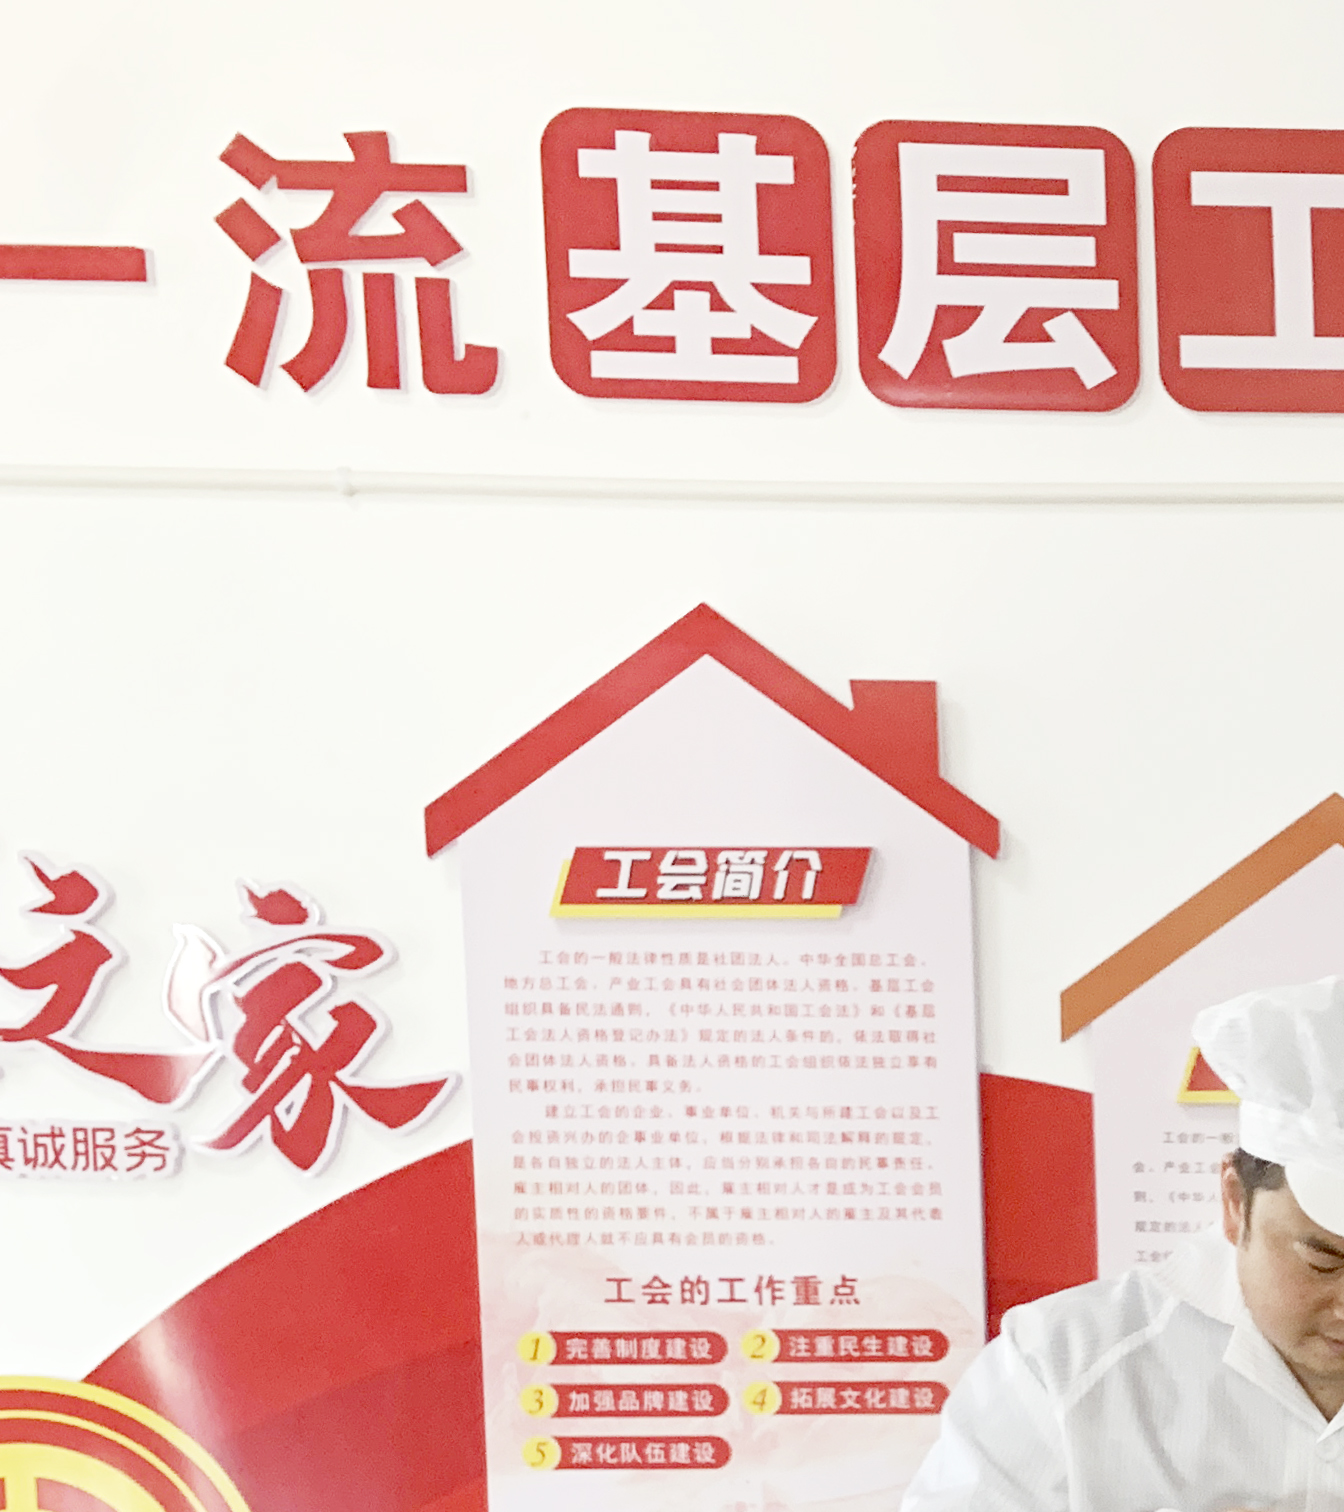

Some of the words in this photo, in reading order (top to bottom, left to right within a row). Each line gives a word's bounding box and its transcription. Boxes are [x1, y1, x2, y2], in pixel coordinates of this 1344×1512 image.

[596, 849, 822, 902] 工会简介
[604, 1275, 860, 1305] 工会的工作重点
[529, 1338, 541, 1361] 1
[566, 1338, 713, 1361] 完善制度建设
[750, 1335, 767, 1358] 2
[789, 1335, 933, 1357] 注重民生建设
[529, 1389, 544, 1414] 3
[570, 1390, 714, 1412] 加强品牌建设
[750, 1386, 767, 1407] 4
[790, 1387, 935, 1410] 拓展文化建设
[531, 1441, 548, 1467] 5
[571, 1442, 716, 1465] 深化队伍建设
